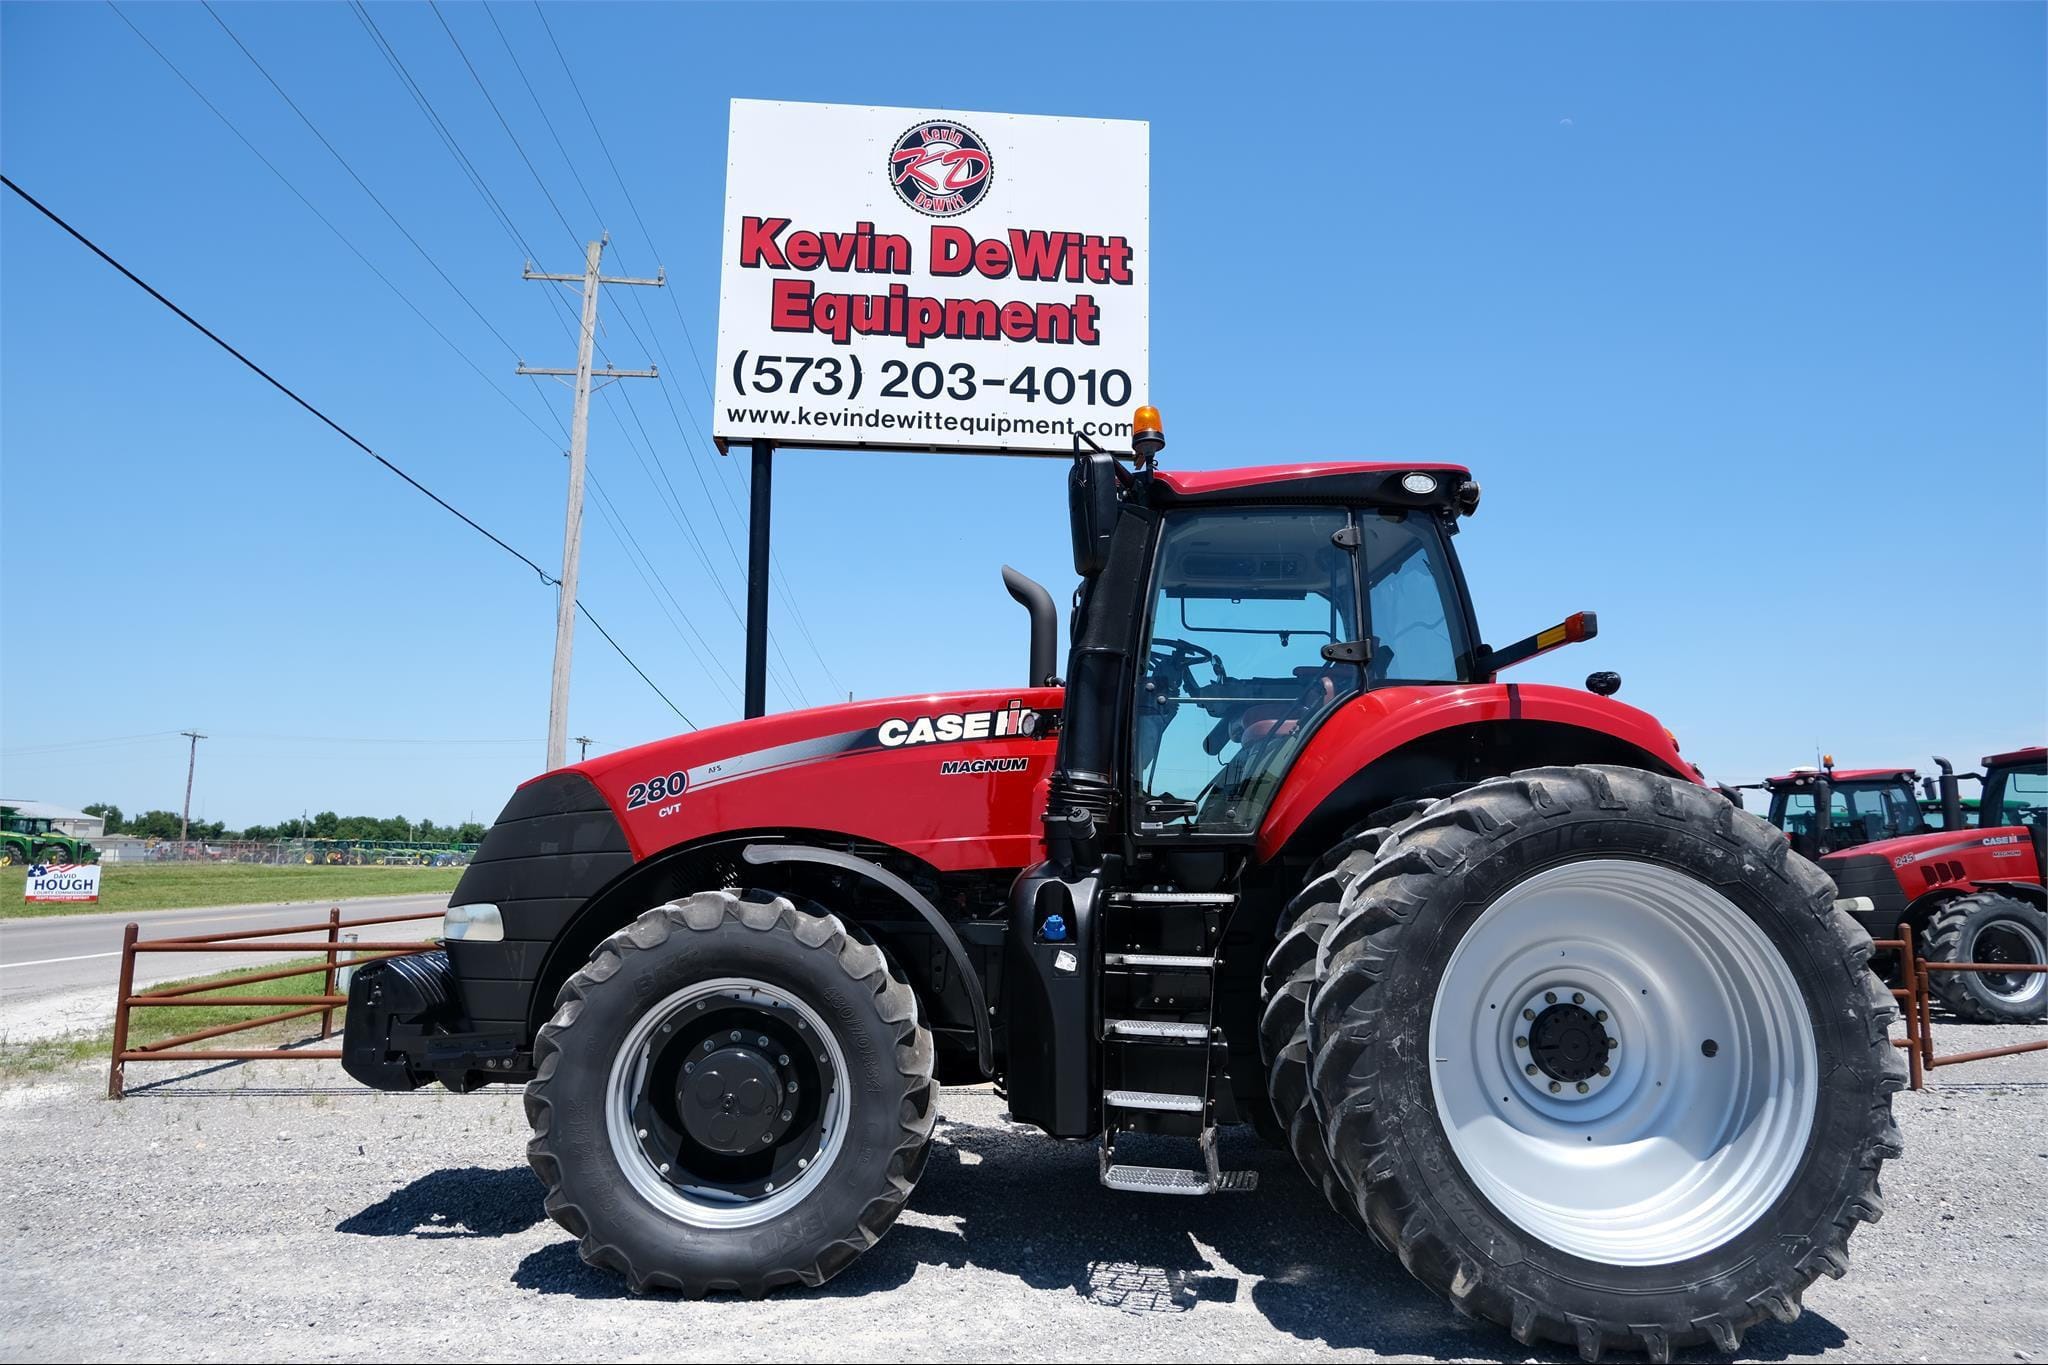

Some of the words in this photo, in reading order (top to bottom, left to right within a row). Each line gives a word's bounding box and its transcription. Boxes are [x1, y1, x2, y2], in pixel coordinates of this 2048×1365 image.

[919, 127, 964, 144] Kevin
[914, 191, 967, 211] DeWitt
[740, 216, 912, 275] Kevin
[929, 225, 1133, 285] DeWitt
[771, 279, 1100, 348] Equipment
[732, 349, 863, 400] (573)
[880, 359, 1132, 407] 203-4010
[727, 406, 1133, 437] www.kevindewittequipmentcom
[878, 712, 991, 747] CASE
[940, 758, 1029, 776] MAGNUM
[626, 770, 688, 812] 280
[658, 802, 682, 818] CVT
[1982, 836, 2008, 846] CASE
[1895, 852, 1915, 868] 245
[34, 879, 93, 890] HOUGH
